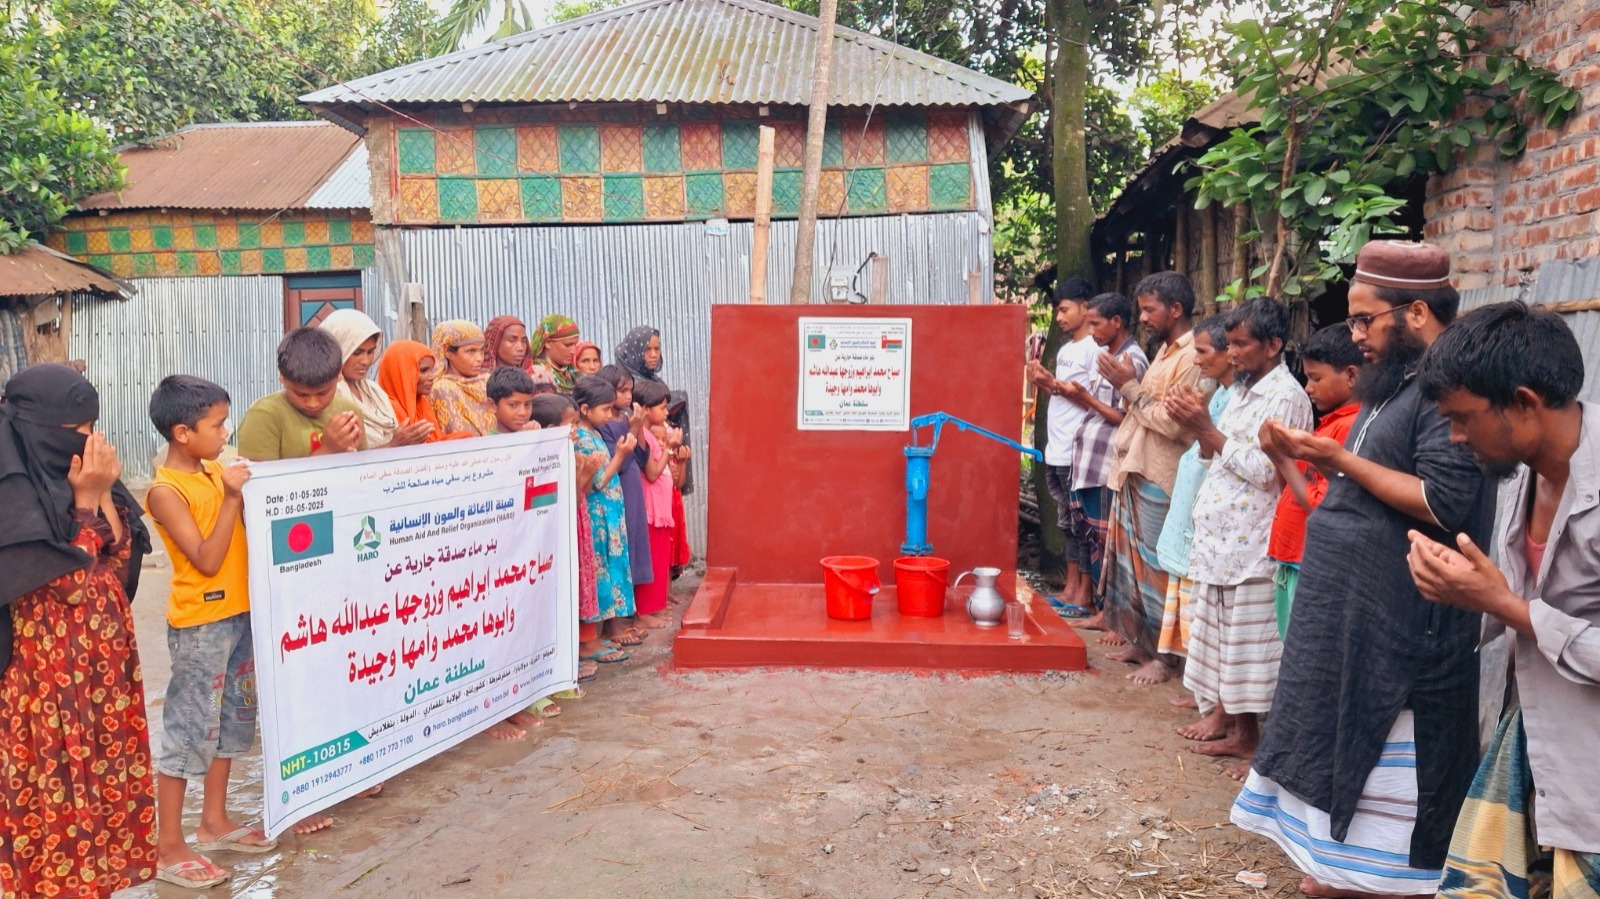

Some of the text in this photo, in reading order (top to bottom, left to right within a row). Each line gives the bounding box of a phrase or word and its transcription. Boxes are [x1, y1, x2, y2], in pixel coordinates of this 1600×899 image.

[266, 494, 284, 504] Date
[290, 487, 328, 500] 01-05-2025
[266, 507, 280, 517] H.D
[285, 500, 324, 514] 05-05-2025
[496, 498, 514, 512] هيئة
[390, 534, 414, 546] Human
[415, 529, 426, 540] Aid
[427, 526, 440, 537] And
[441, 522, 459, 534] Relief
[460, 517, 496, 531] Organization
[280, 558, 322, 574] Bangladesh
[357, 550, 379, 562] HARO
[405, 552, 435, 576] جارية
[438, 545, 466, 563] صدقة
[530, 550, 554, 585] صباح
[384, 563, 402, 582] عن
[494, 563, 527, 588] محمد
[395, 580, 444, 626] وزوجها
[280, 613, 328, 664] هاشم
[442, 621, 478, 650] محمد
[348, 649, 396, 685] وجيدة
[404, 657, 485, 704] سلطنة عمان
[282, 738, 351, 778] NHT-10815
[292, 782, 310, 796] +880
[312, 764, 352, 788] 1912943777
[359, 754, 374, 766] +880
[376, 746, 386, 758] 172
[388, 742, 398, 754] 773
[400, 735, 414, 748] 7100
[432, 704, 479, 732] haro.bangladesh
